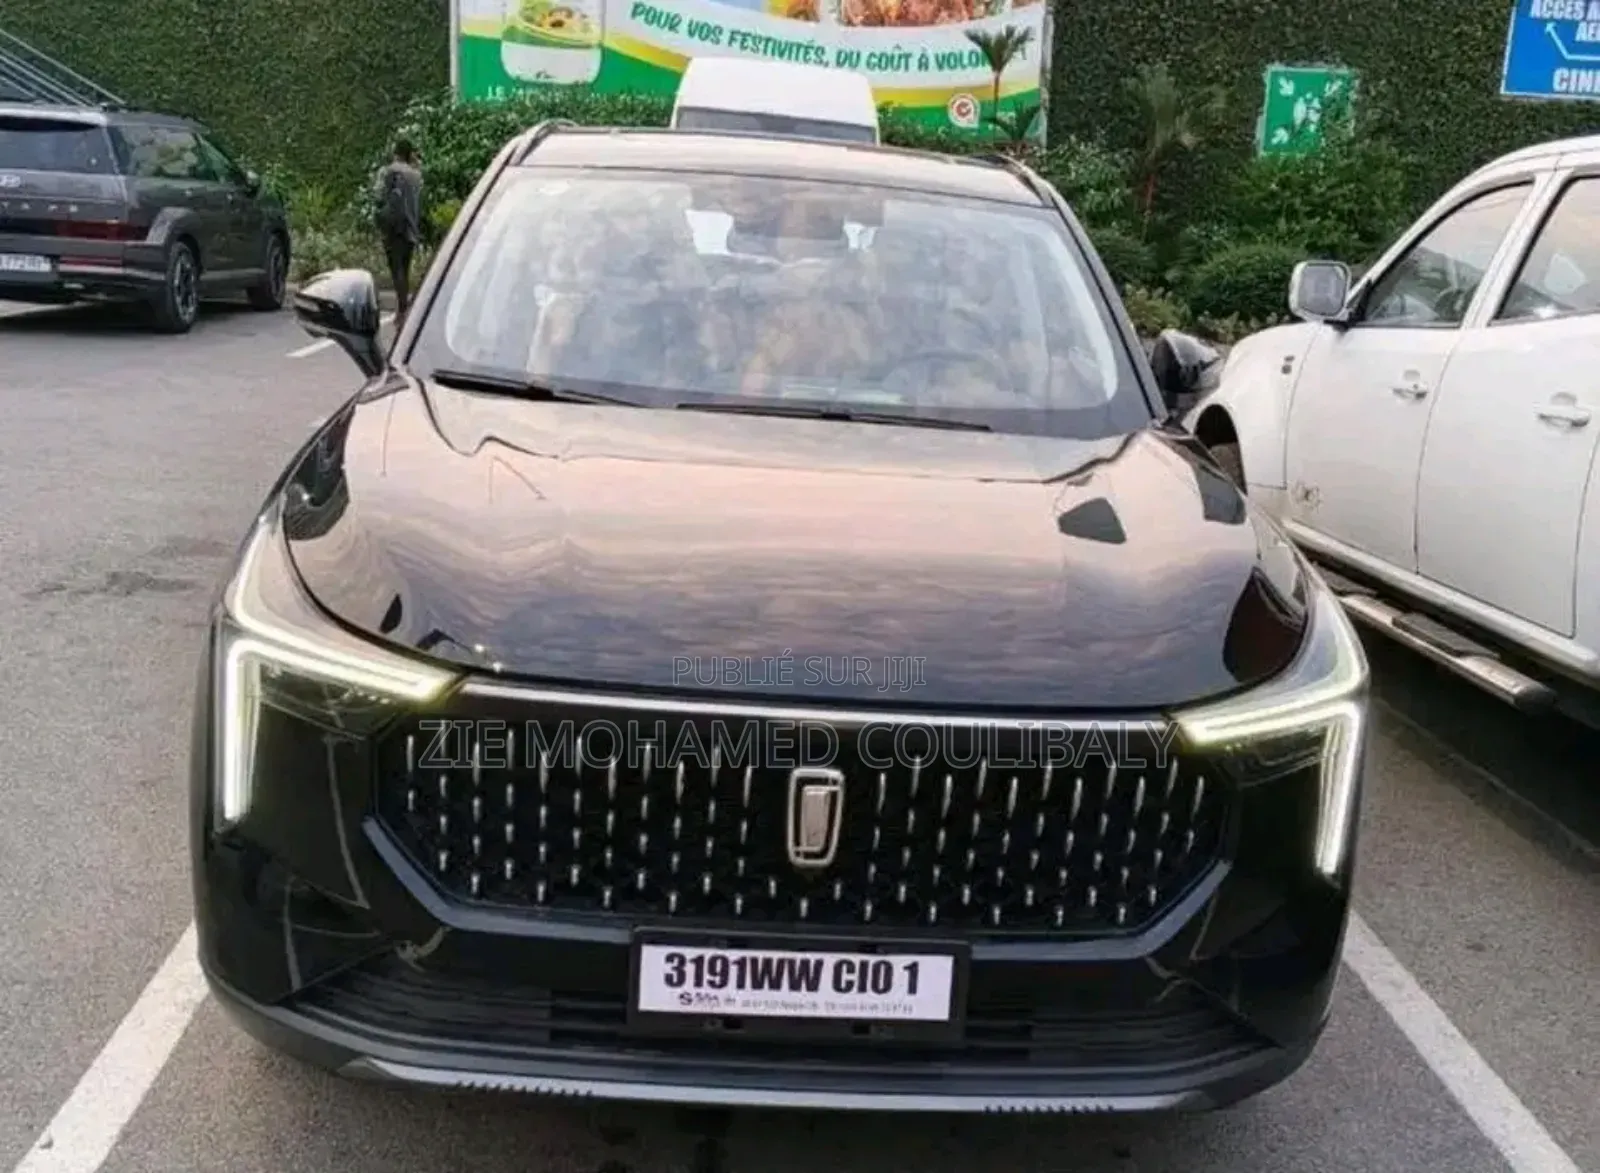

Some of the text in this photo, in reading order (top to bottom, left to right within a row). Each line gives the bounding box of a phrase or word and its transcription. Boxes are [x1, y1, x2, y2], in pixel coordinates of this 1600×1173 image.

[631, 2, 682, 34] POUR
[687, 19, 723, 45] VOS
[728, 29, 829, 68] FESTIVITÉS,
[835, 49, 861, 69] DU
[866, 44, 912, 72] GOÛT
[917, 44, 930, 72] À
[664, 952, 824, 993] 3191WW
